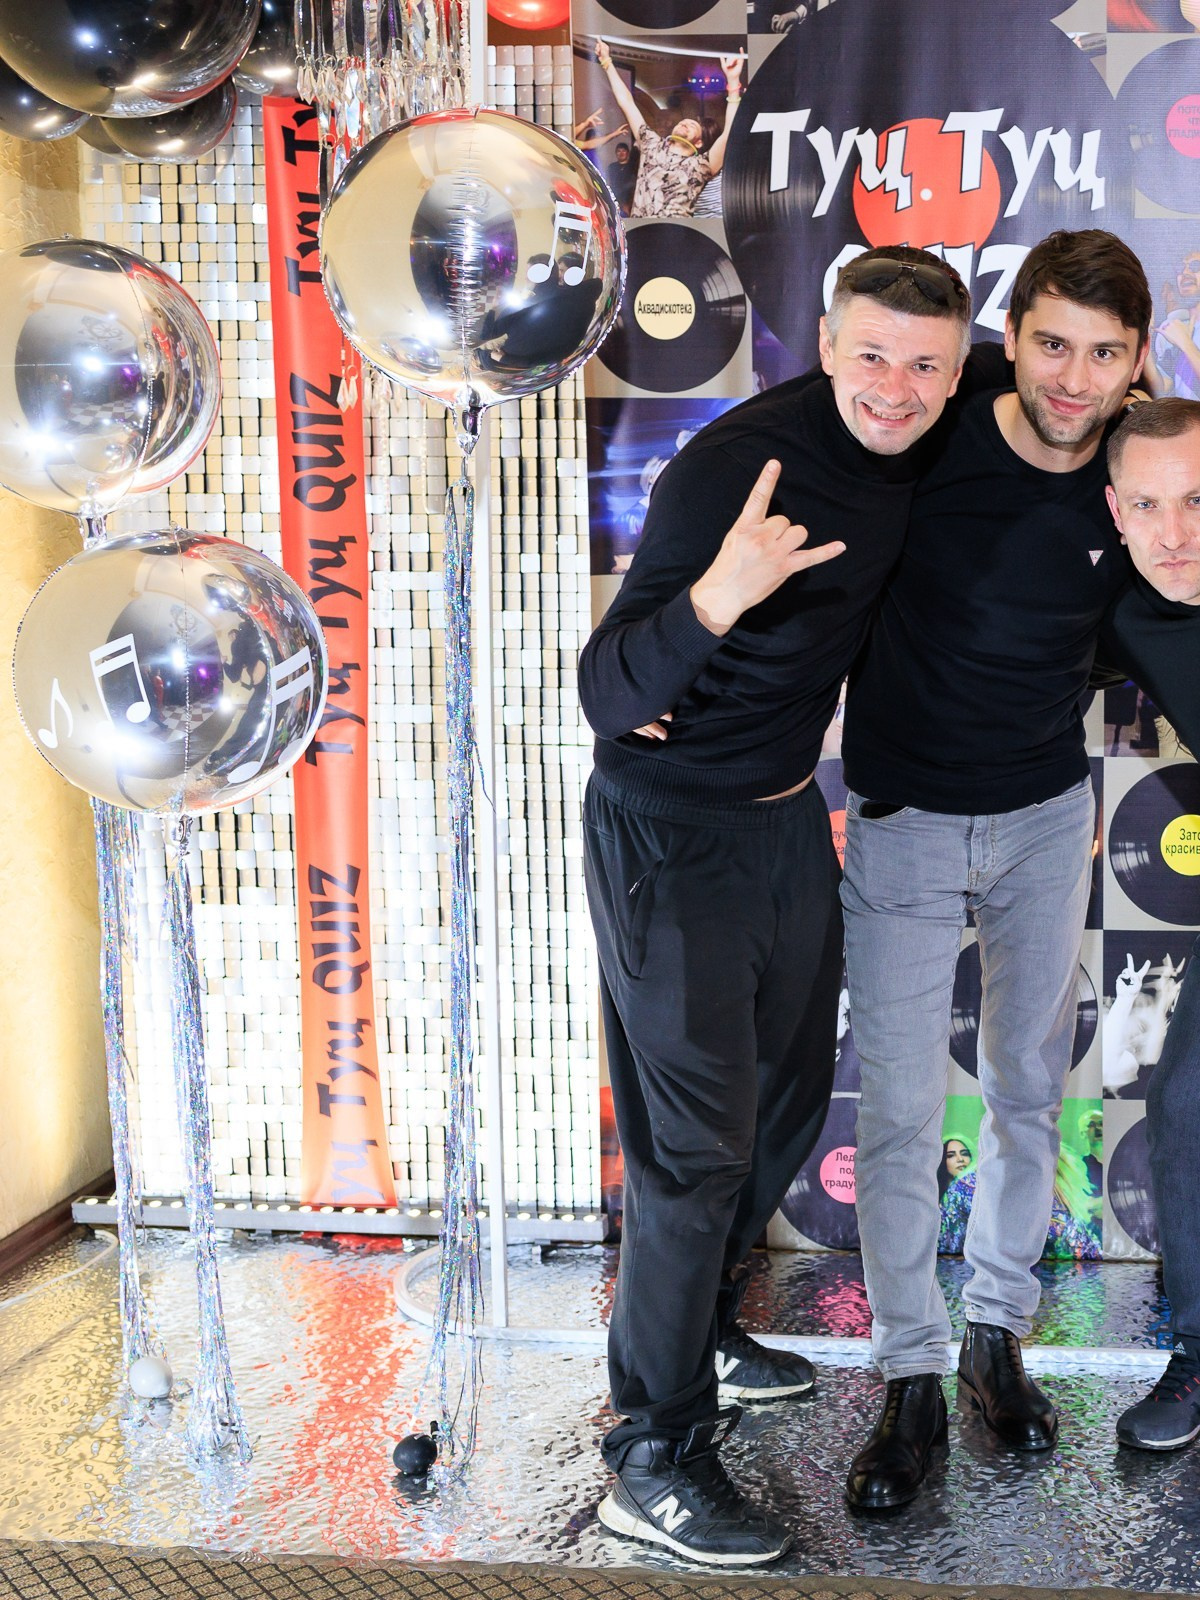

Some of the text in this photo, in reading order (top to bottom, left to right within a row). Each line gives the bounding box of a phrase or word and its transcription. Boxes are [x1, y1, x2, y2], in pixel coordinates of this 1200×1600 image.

[750, 108, 1105, 219] Туц Туц
[638, 299, 692, 316] Аквадискотека
[290, 372, 357, 513] QUIZ
[308, 864, 371, 995] QUIZ
[316, 1018, 377, 1118] Туц
[331, 1139, 385, 1203] уц
[825, 1179, 856, 1190] граду
[650, 1494, 693, 1533] N
